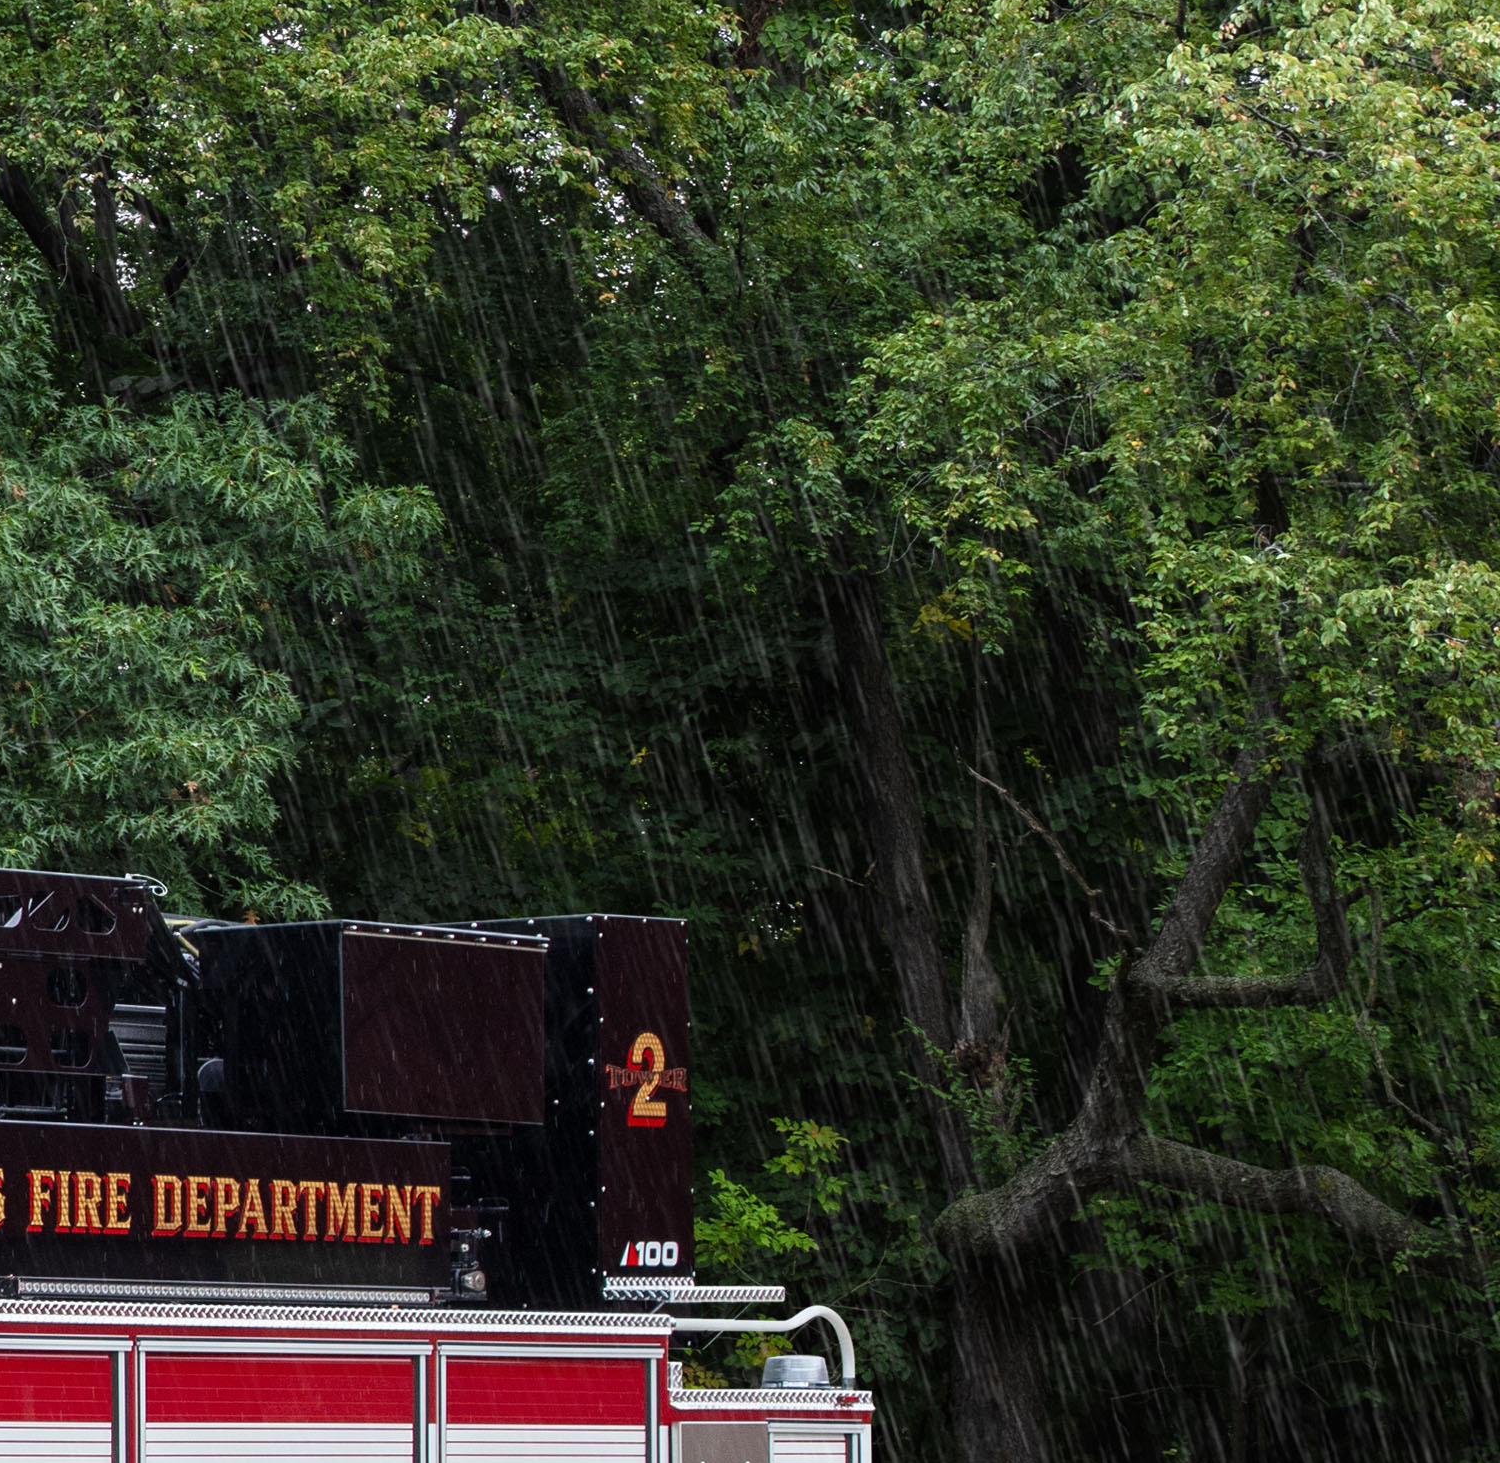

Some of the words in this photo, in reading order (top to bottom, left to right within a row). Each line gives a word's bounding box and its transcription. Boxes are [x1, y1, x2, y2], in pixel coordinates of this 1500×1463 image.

[604, 1063, 689, 1093] TOWER
[627, 1031, 668, 1128] 2
[25, 1168, 133, 1236] FIRE
[150, 1173, 441, 1245] DEPARTMENT
